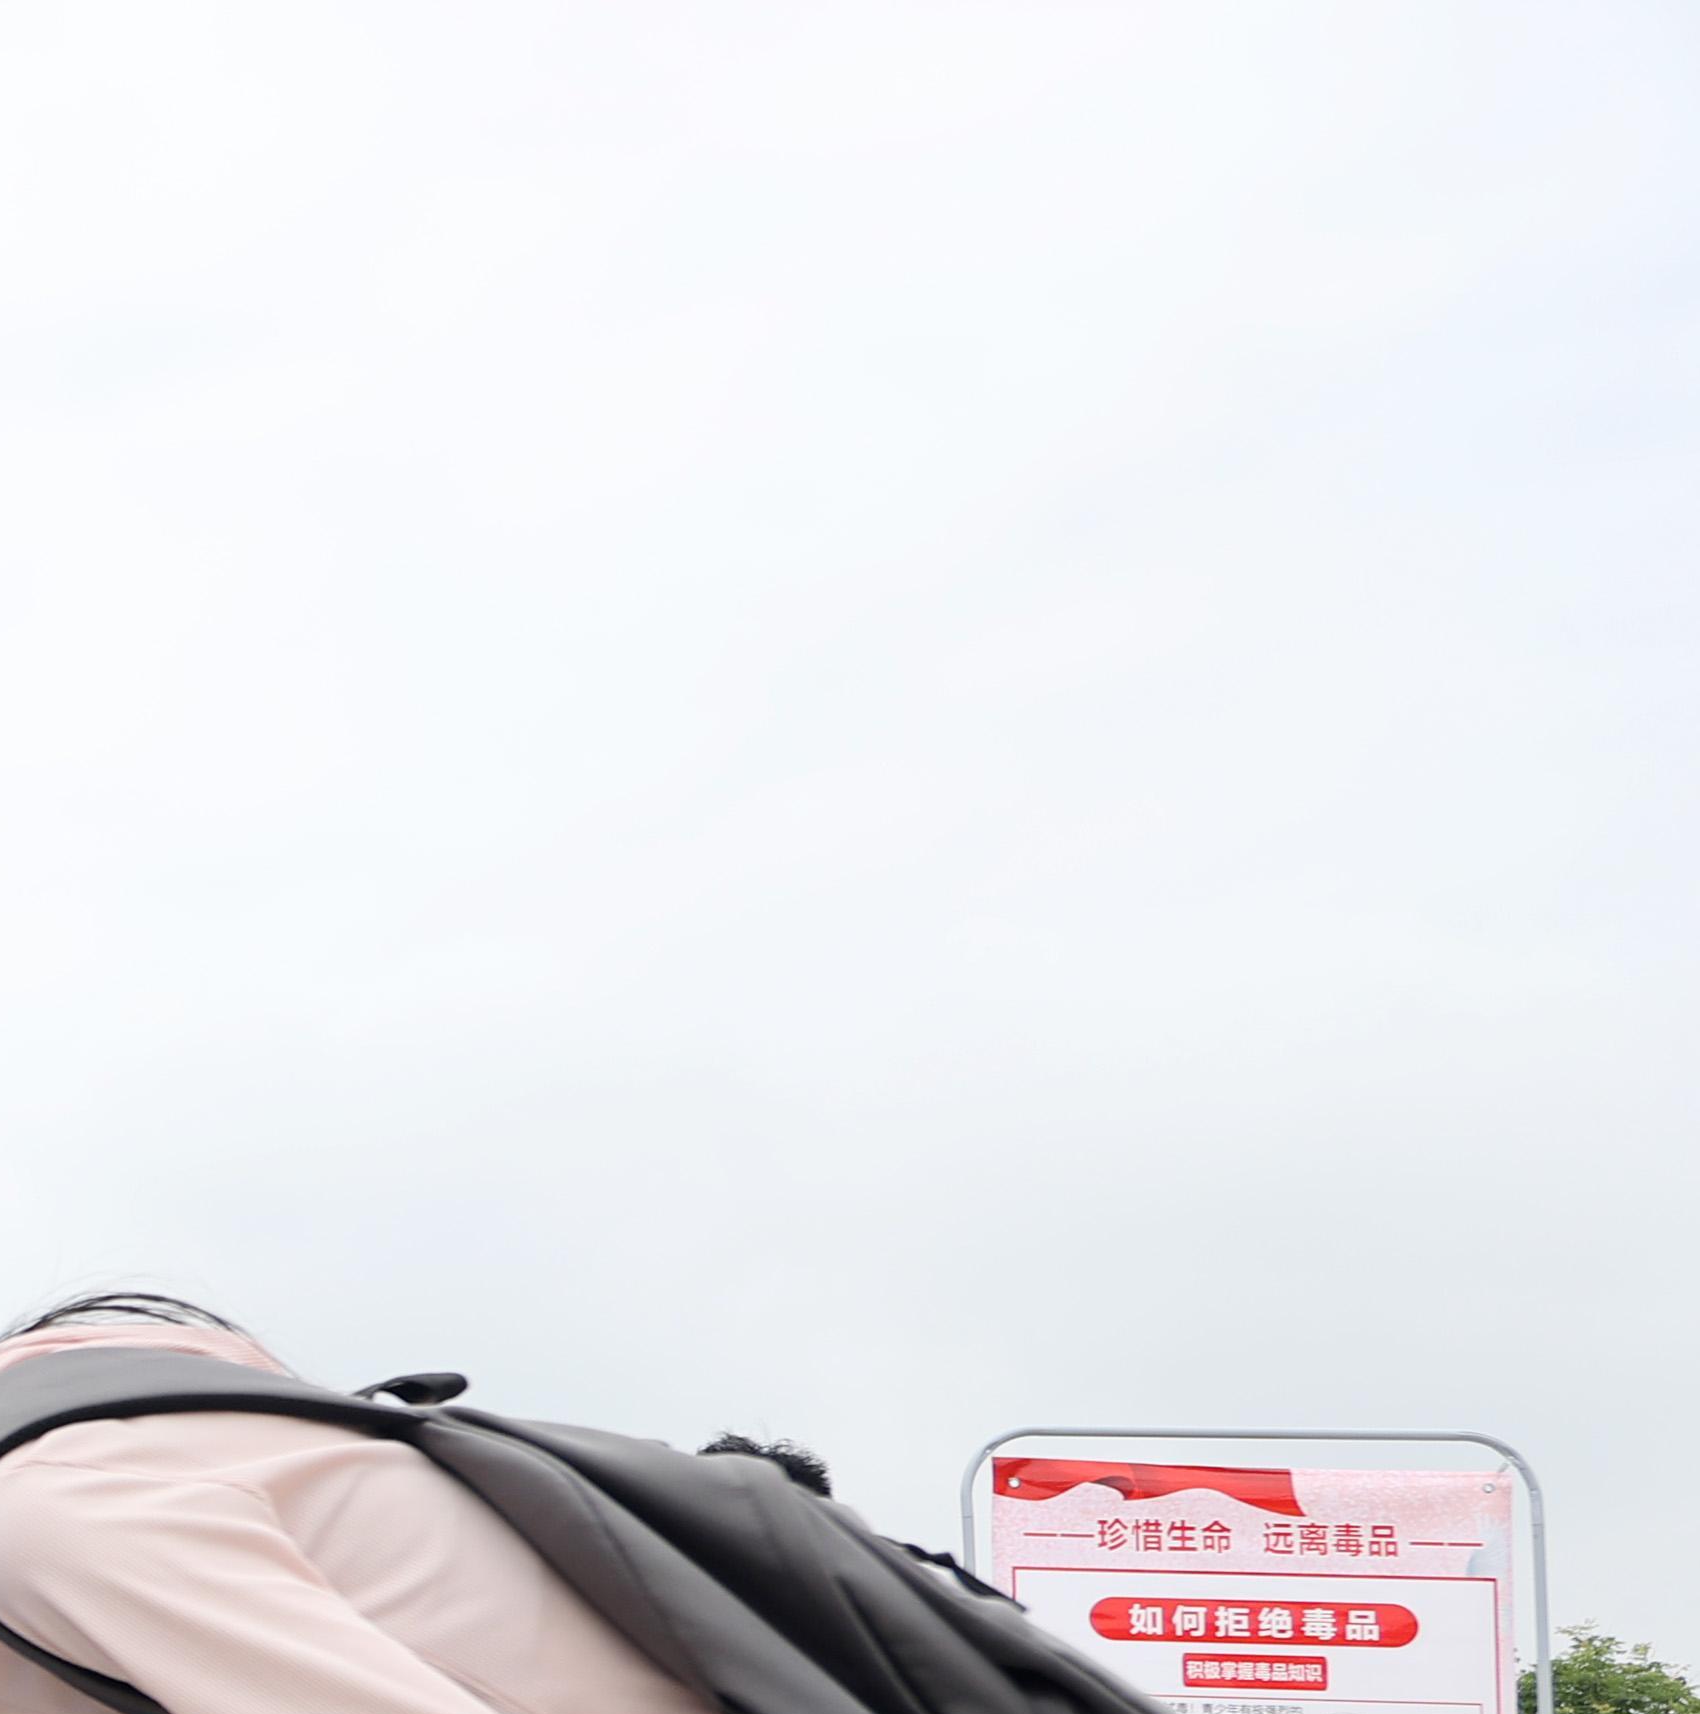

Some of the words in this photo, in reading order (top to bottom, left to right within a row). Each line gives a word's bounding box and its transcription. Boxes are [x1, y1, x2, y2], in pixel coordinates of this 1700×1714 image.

[1128, 1602, 1382, 1643] 如何拒绝毒品
[1185, 1659, 1325, 1683] 积极掌握毒品知识
